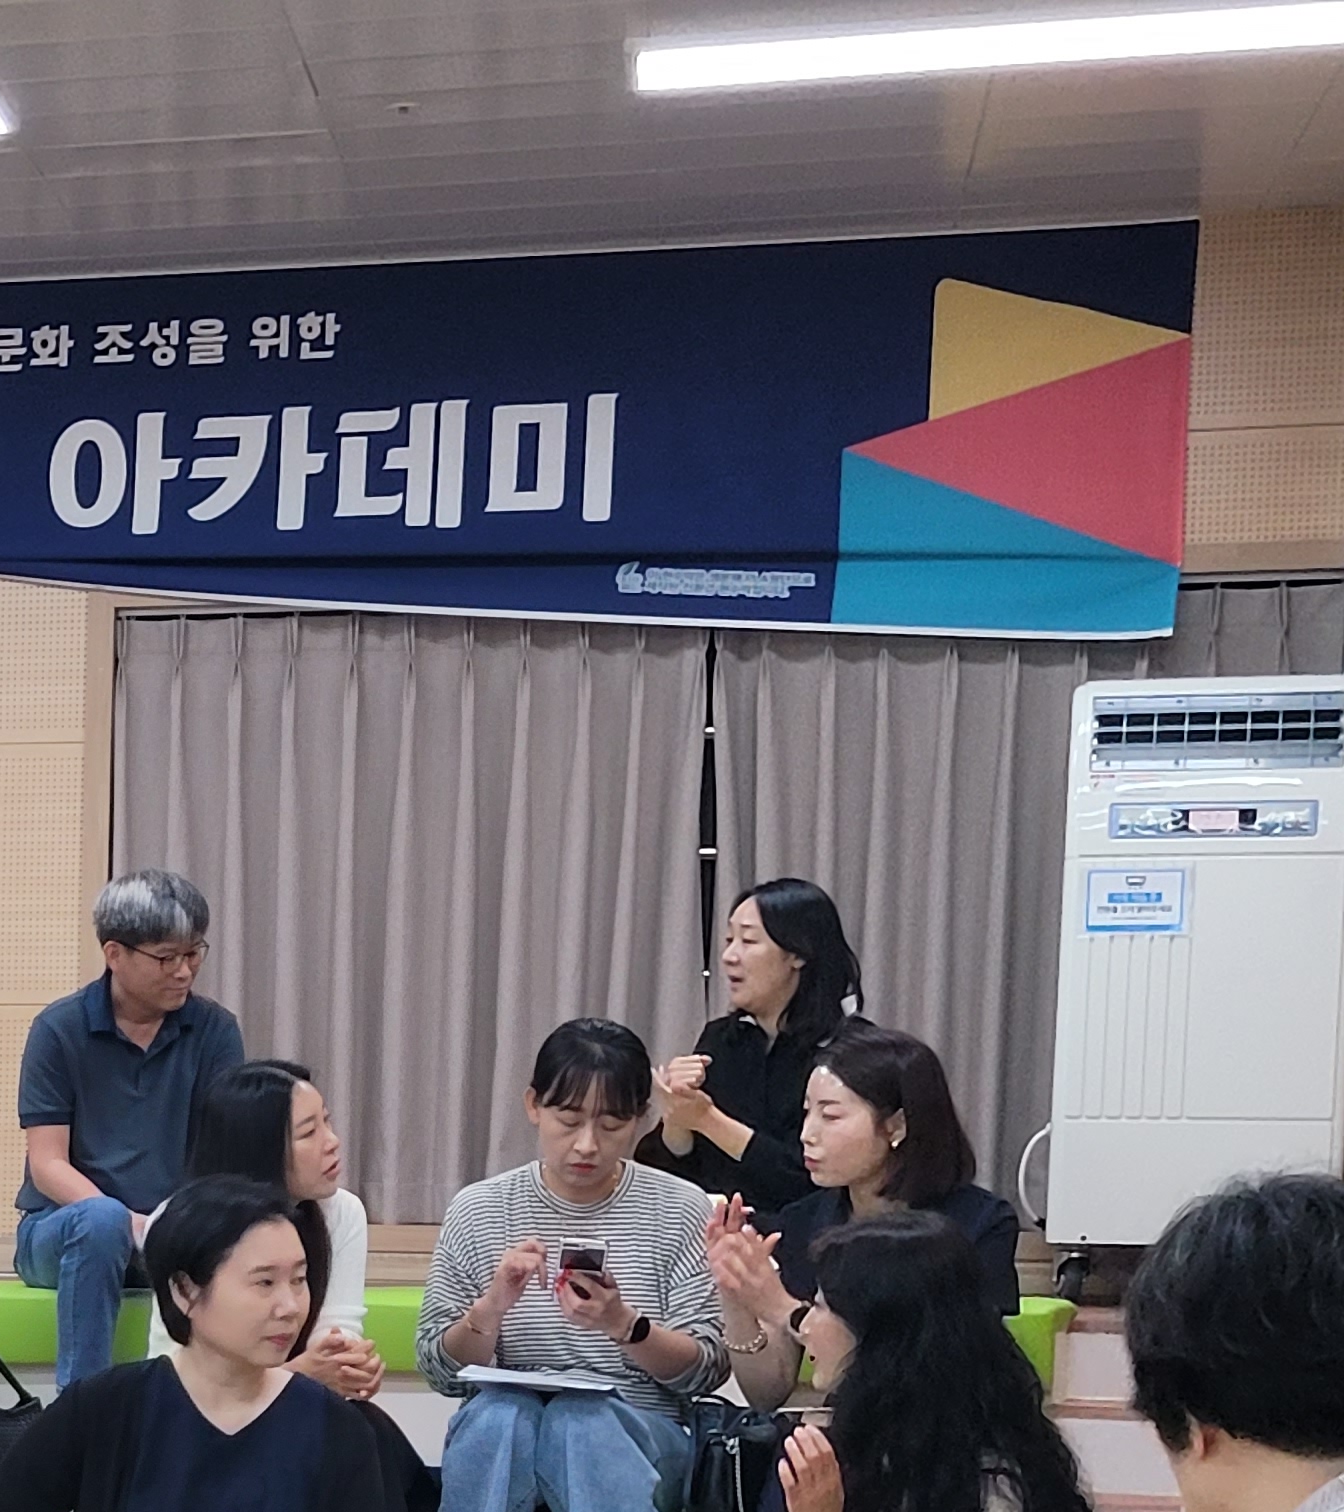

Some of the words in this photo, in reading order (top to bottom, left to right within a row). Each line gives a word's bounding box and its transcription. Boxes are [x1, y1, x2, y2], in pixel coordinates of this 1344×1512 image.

[92, 317, 229, 367] 조성을
[249, 311, 342, 361] 위한
[48, 392, 622, 533] 아카데미
